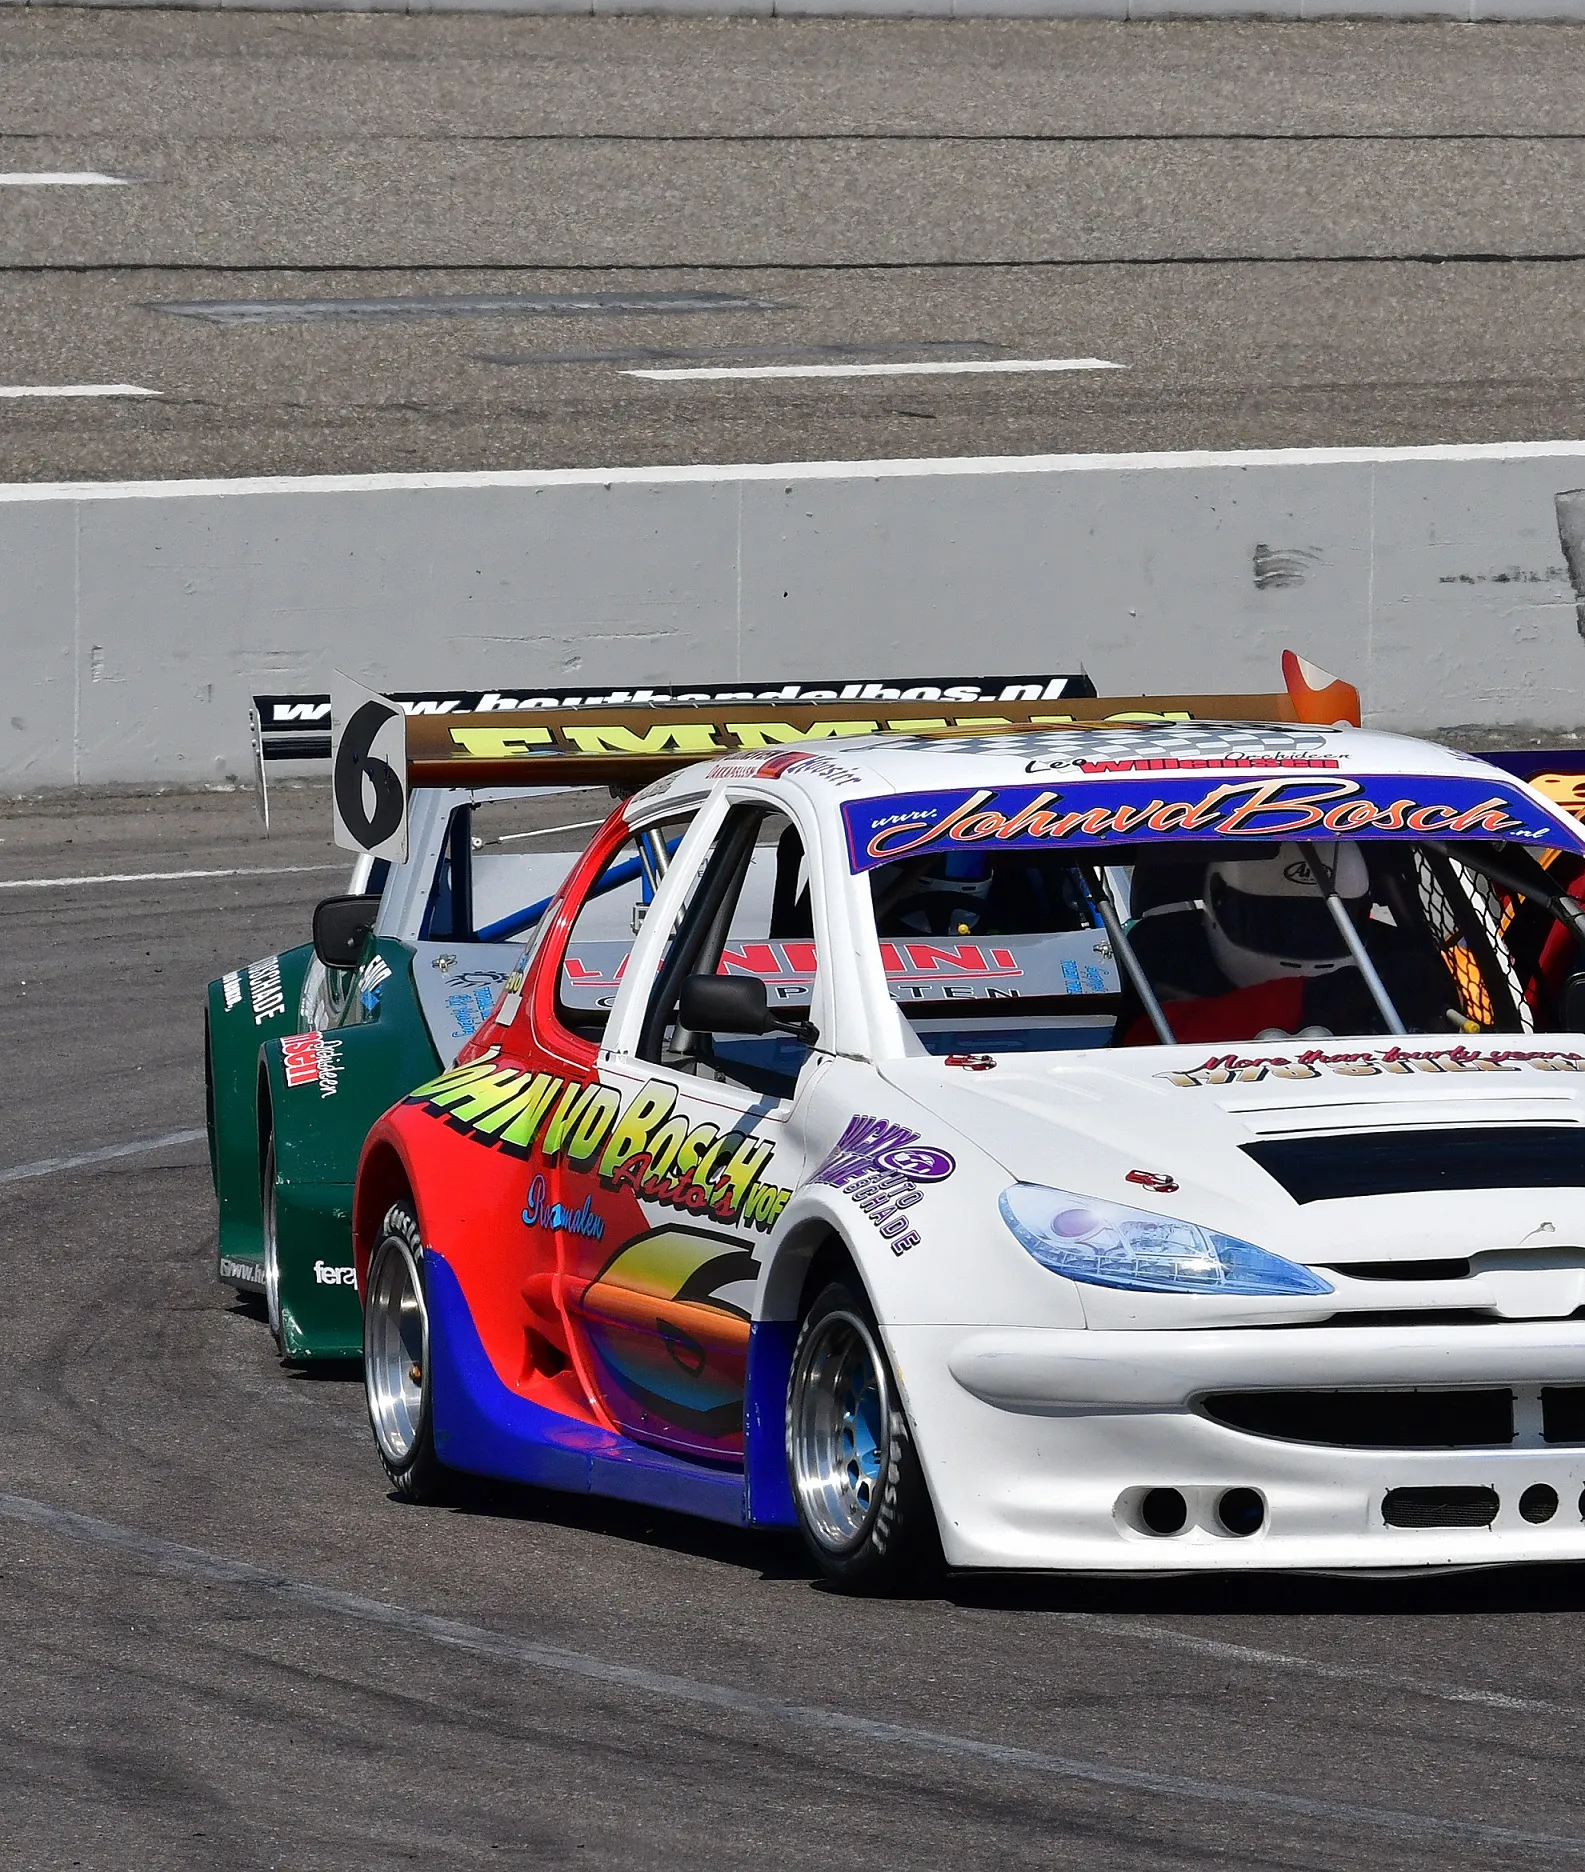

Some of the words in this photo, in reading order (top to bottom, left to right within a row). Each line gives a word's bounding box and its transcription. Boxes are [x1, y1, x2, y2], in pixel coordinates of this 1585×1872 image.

[271, 678, 1068, 721] ww.houthdelbos.nl
[334, 700, 406, 850] 6
[1025, 758, 1086, 774] Leo
[1225, 751, 1352, 763] Orchideen
[866, 776, 1524, 859] JohnvdBosch
[1188, 1054, 1291, 1072] More
[1294, 1049, 1375, 1065] than
[1489, 1050, 1585, 1062] years
[598, 1077, 776, 1211] BOSCH
